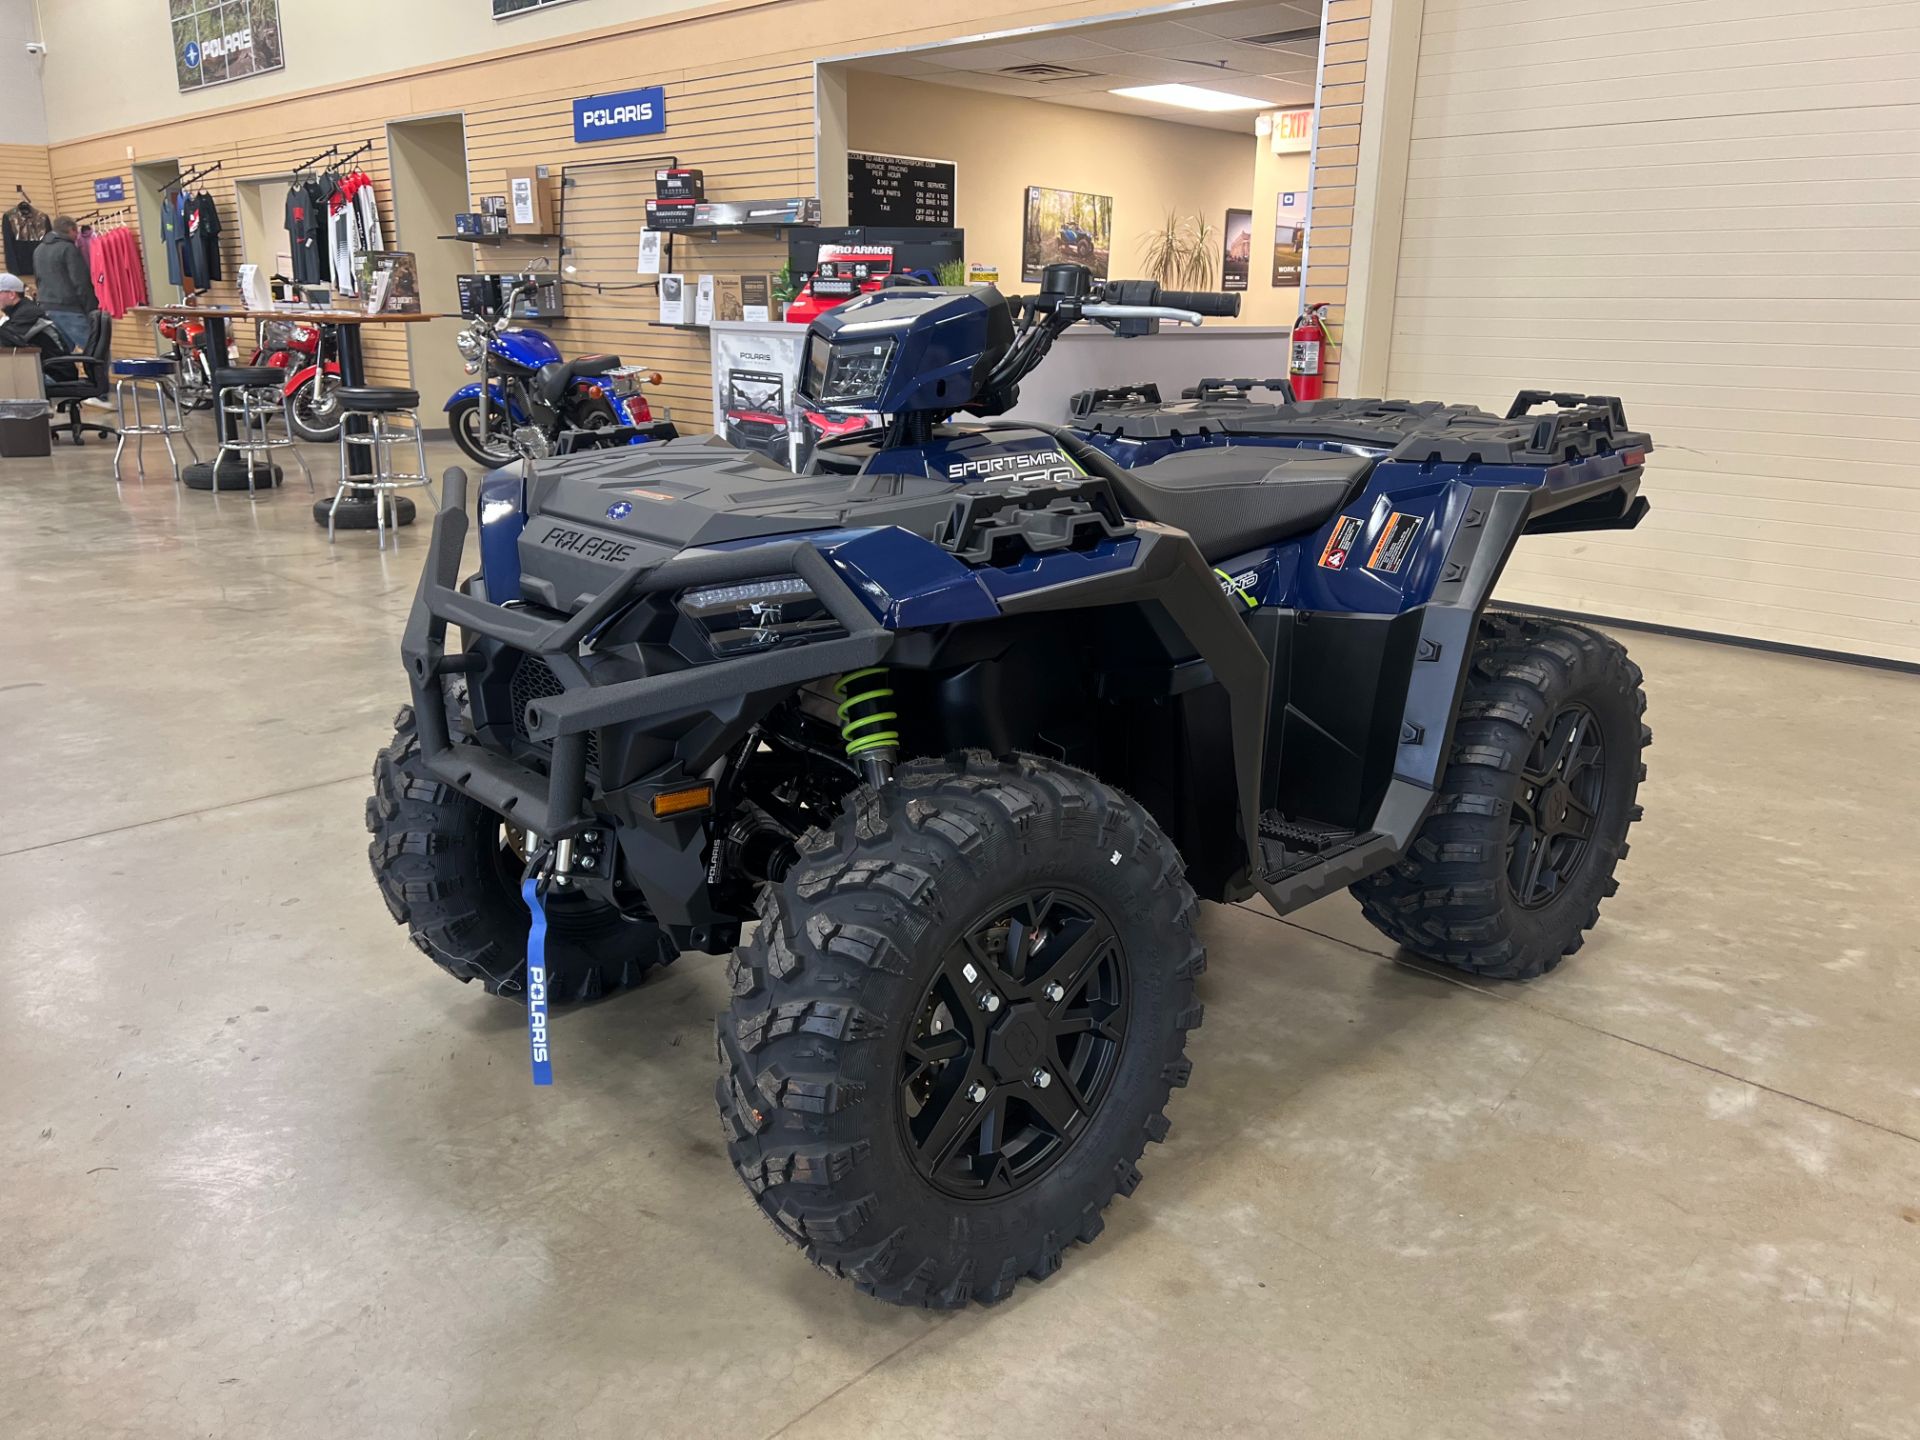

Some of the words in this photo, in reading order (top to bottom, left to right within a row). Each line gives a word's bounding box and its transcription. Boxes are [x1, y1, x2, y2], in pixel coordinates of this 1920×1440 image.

[201, 28, 252, 60] POLARIS
[583, 103, 653, 128] POLARIS
[1281, 112, 1310, 138] EXIT
[832, 246, 852, 254] PRO
[852, 246, 893, 255] ARMOR
[740, 352, 771, 361] POLARIS
[949, 452, 1066, 479] SPORTSMAN
[540, 527, 637, 563] POLARIS
[707, 839, 721, 884] POLARIS
[530, 966, 548, 1064] POLARIS
